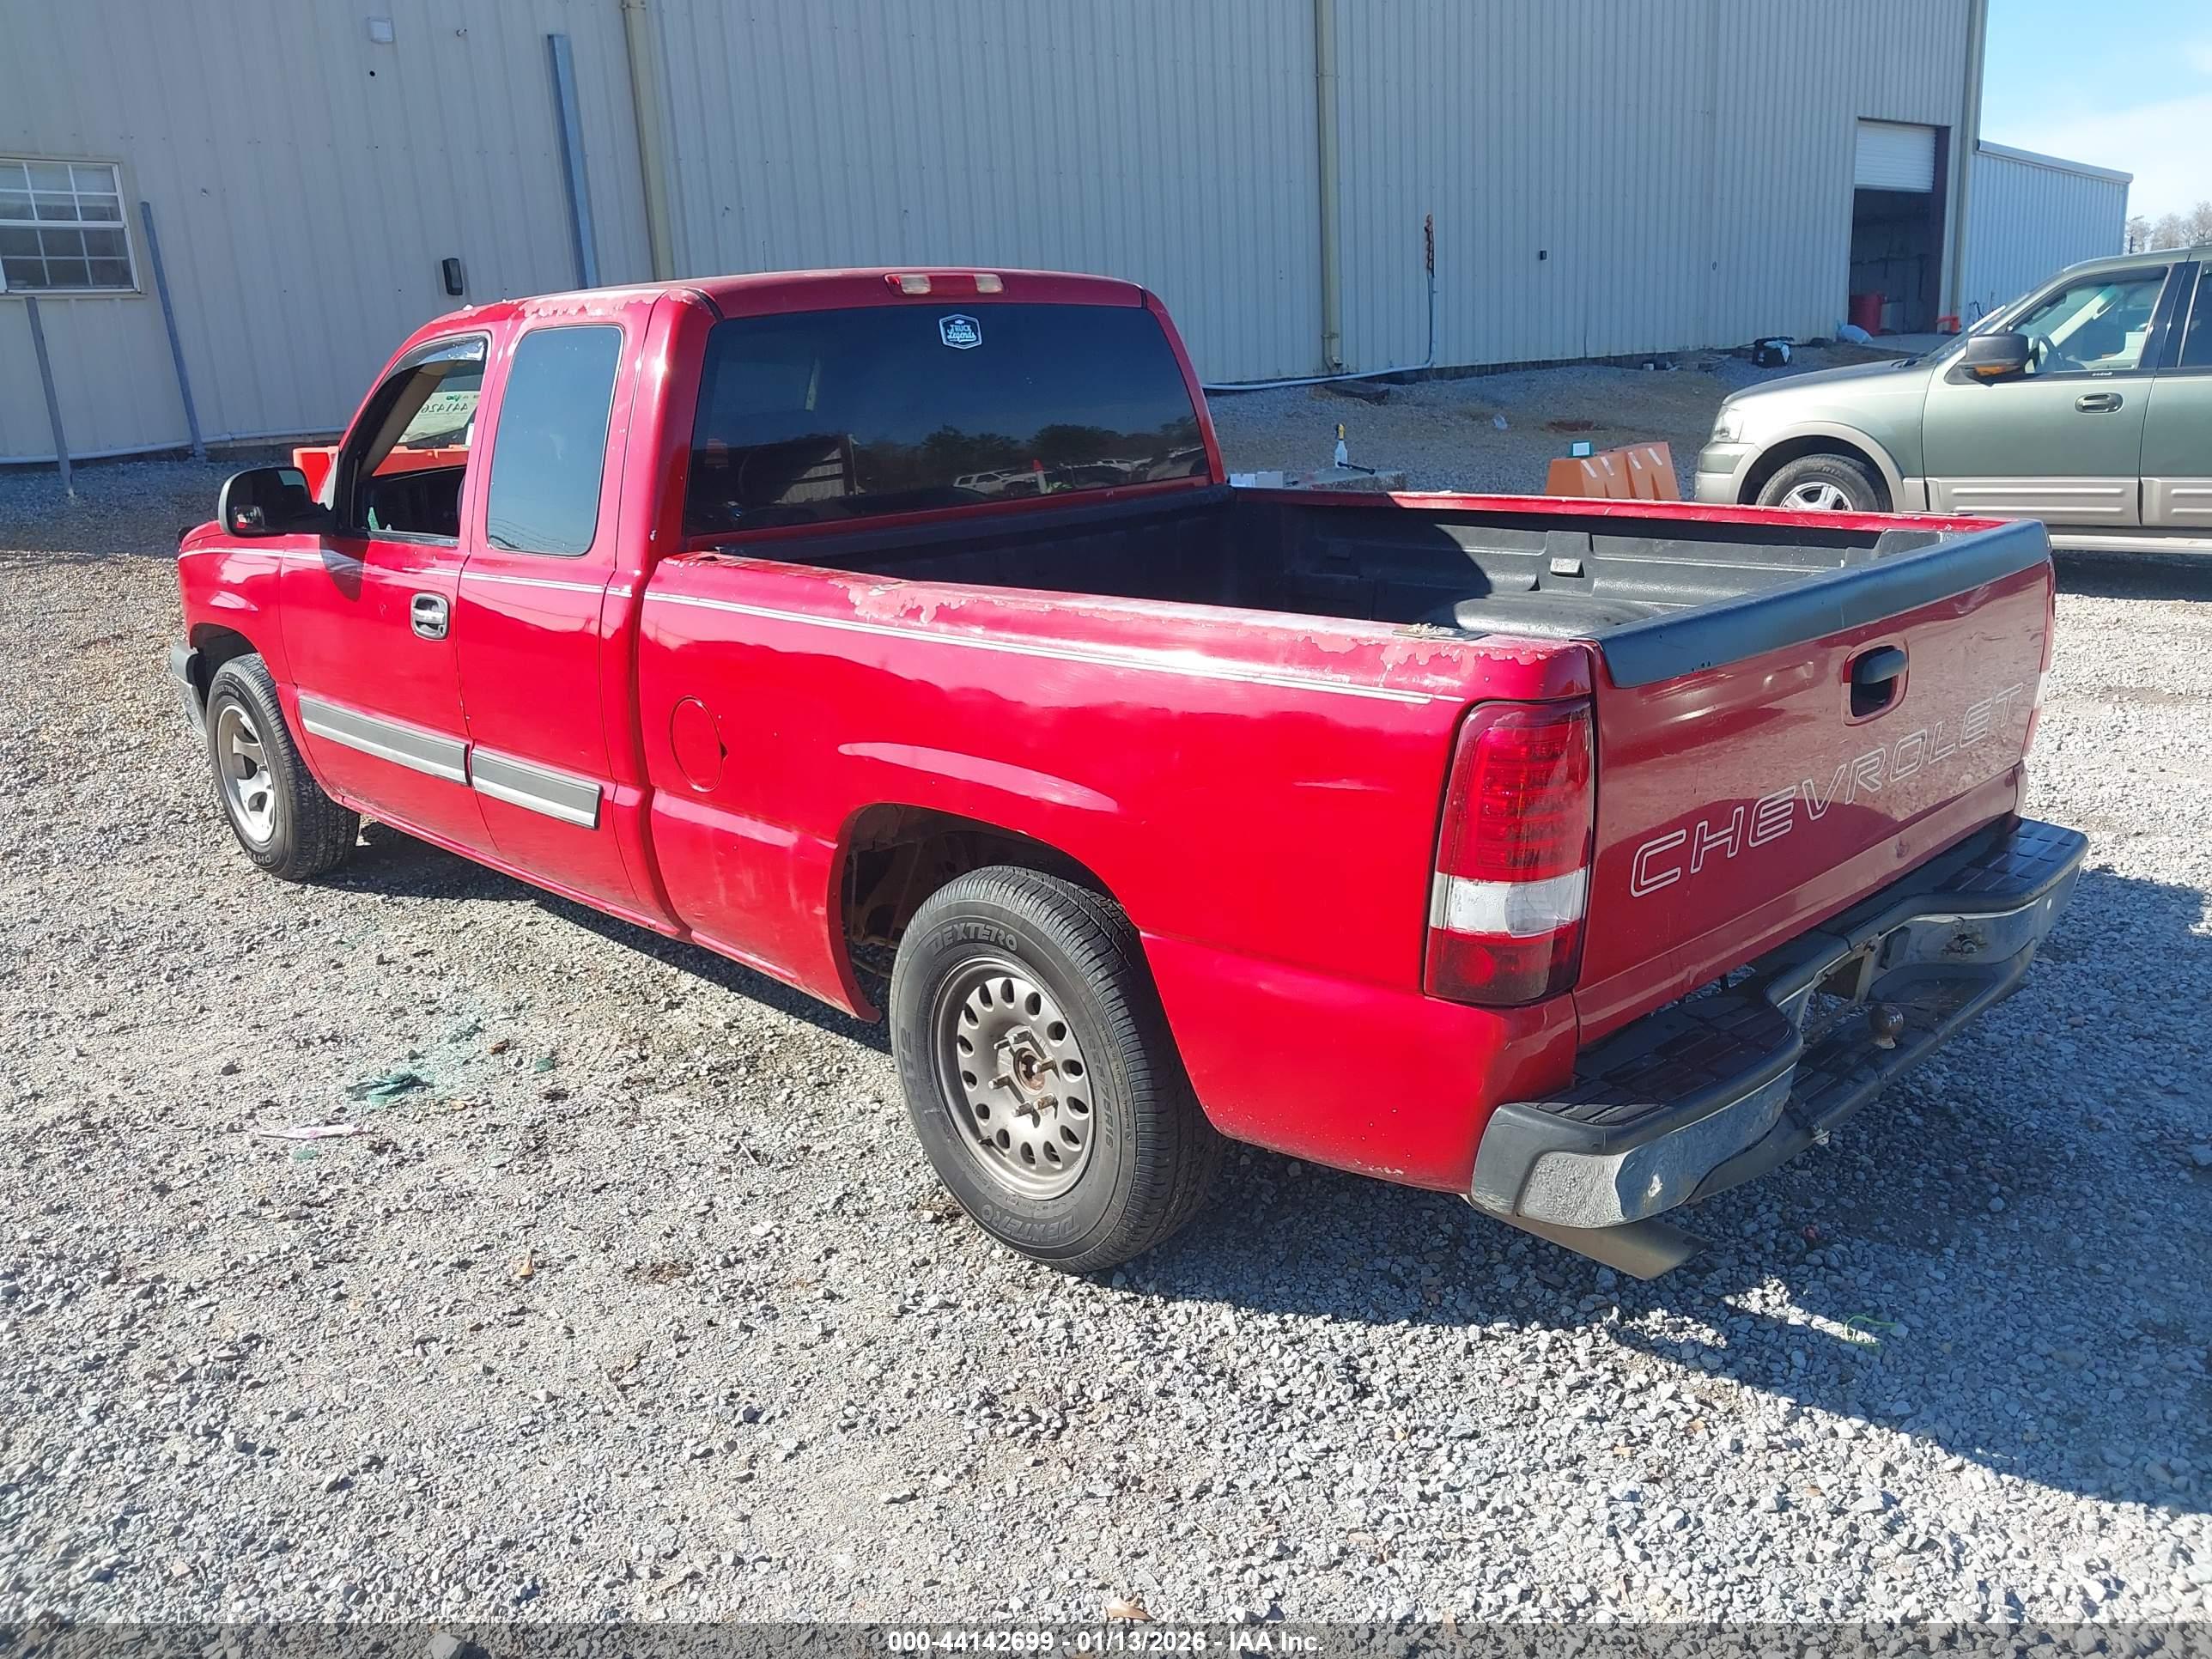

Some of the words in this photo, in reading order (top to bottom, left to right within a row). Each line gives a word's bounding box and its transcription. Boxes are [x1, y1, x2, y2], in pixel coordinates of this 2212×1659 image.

[1630, 681, 2025, 898] CHEVROLET
[926, 921, 1018, 957] DEXTERO
[981, 1202, 1081, 1243] DEXTERO
